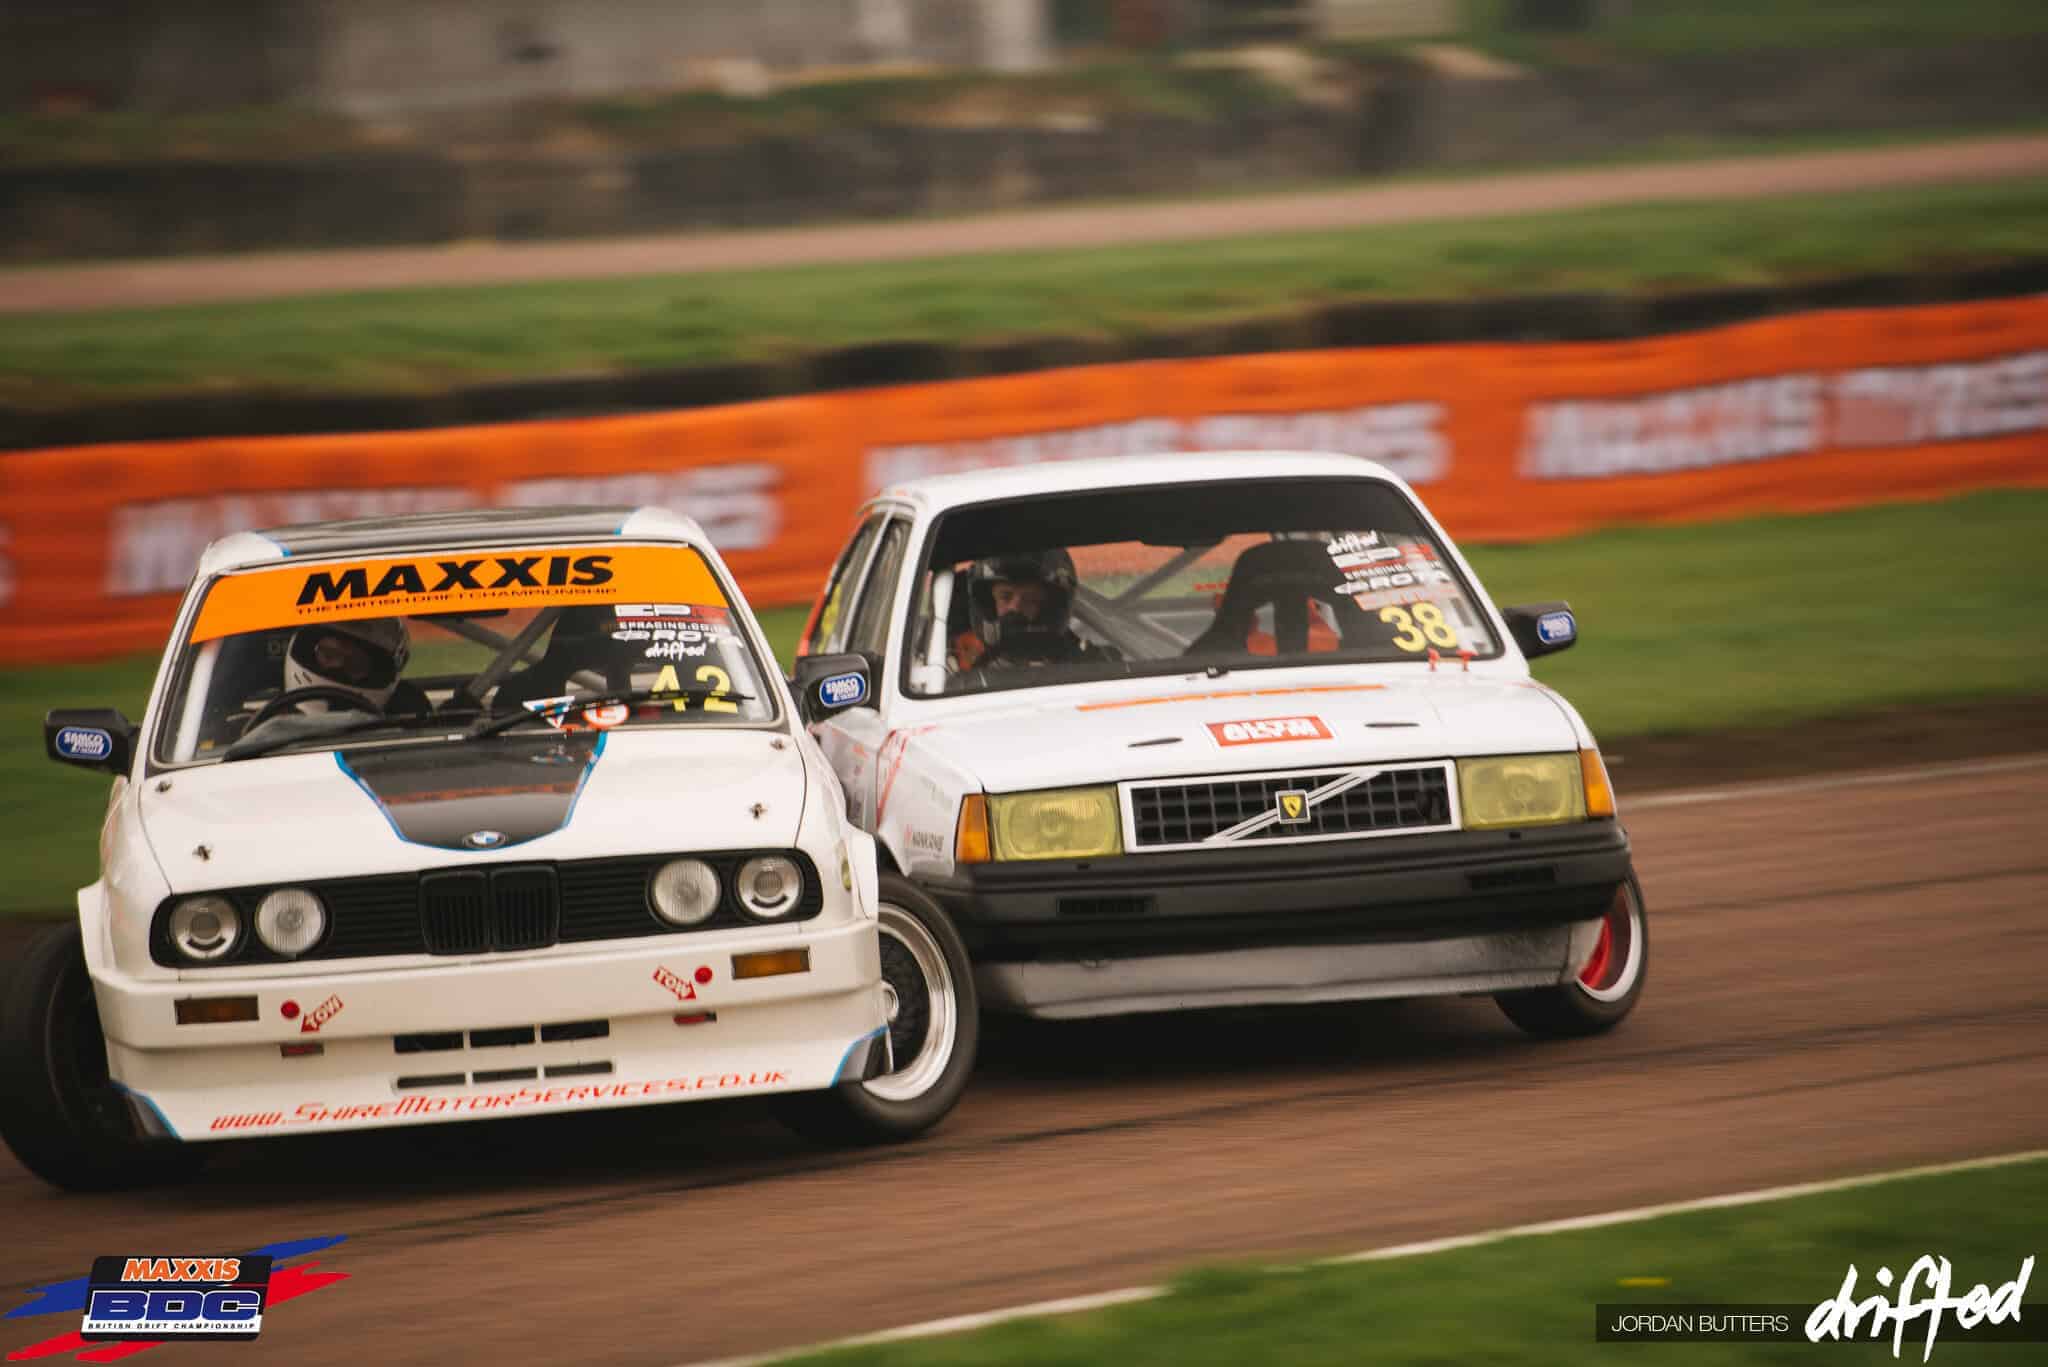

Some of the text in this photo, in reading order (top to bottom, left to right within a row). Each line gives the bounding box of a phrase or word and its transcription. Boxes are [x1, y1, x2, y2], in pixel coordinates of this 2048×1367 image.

[296, 556, 614, 606] MAXXIS
[1379, 602, 1458, 652] 38
[645, 641, 707, 661] drifted
[652, 664, 739, 713] 42
[655, 968, 693, 998] TOW
[304, 995, 342, 1029] TOW
